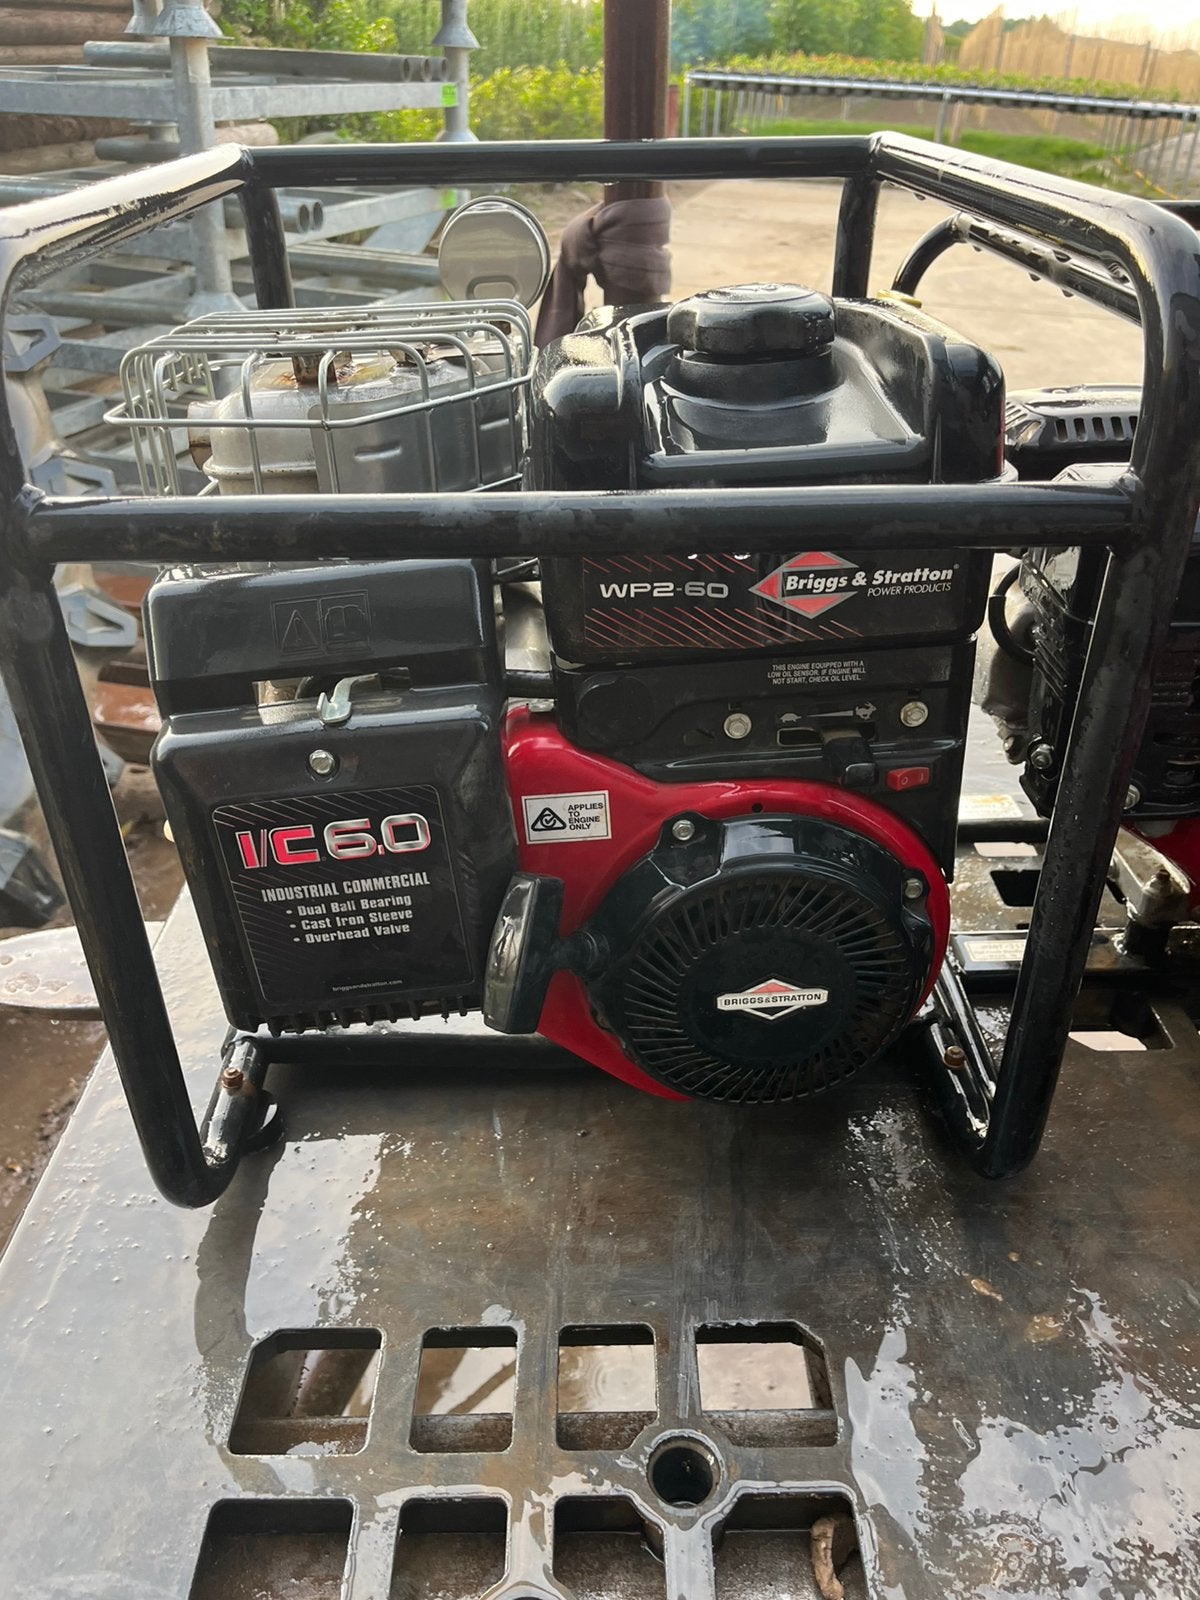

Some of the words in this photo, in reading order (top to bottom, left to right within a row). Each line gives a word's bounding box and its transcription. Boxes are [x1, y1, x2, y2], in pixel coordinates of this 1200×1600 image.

[785, 573, 849, 593] Briggs
[851, 571, 867, 586] &
[871, 567, 953, 586] Stratton
[599, 581, 729, 599] WP2-60
[867, 586, 901, 597] POWER
[903, 582, 951, 595] PRODUCTS
[787, 663, 810, 671] ENGINE
[811, 661, 842, 669] EQUIPPED
[828, 667, 851, 675] ENGINE
[567, 802, 604, 812] APPLIES
[568, 816, 600, 824] ENGINE
[569, 823, 591, 831] ONLY
[261, 882, 339, 902] INDUSTRIAL
[343, 872, 430, 894] COMMERCIAL
[297, 905, 326, 917] Dual
[331, 900, 356, 913] Ball
[361, 895, 412, 910] Bearing
[301, 917, 332, 931] Cast
[336, 913, 364, 926] Iron
[369, 908, 413, 923] Sleeve
[305, 927, 370, 944] Overhead
[374, 923, 410, 936] Valve
[724, 993, 822, 1006] BRIGGS&STRATTON
